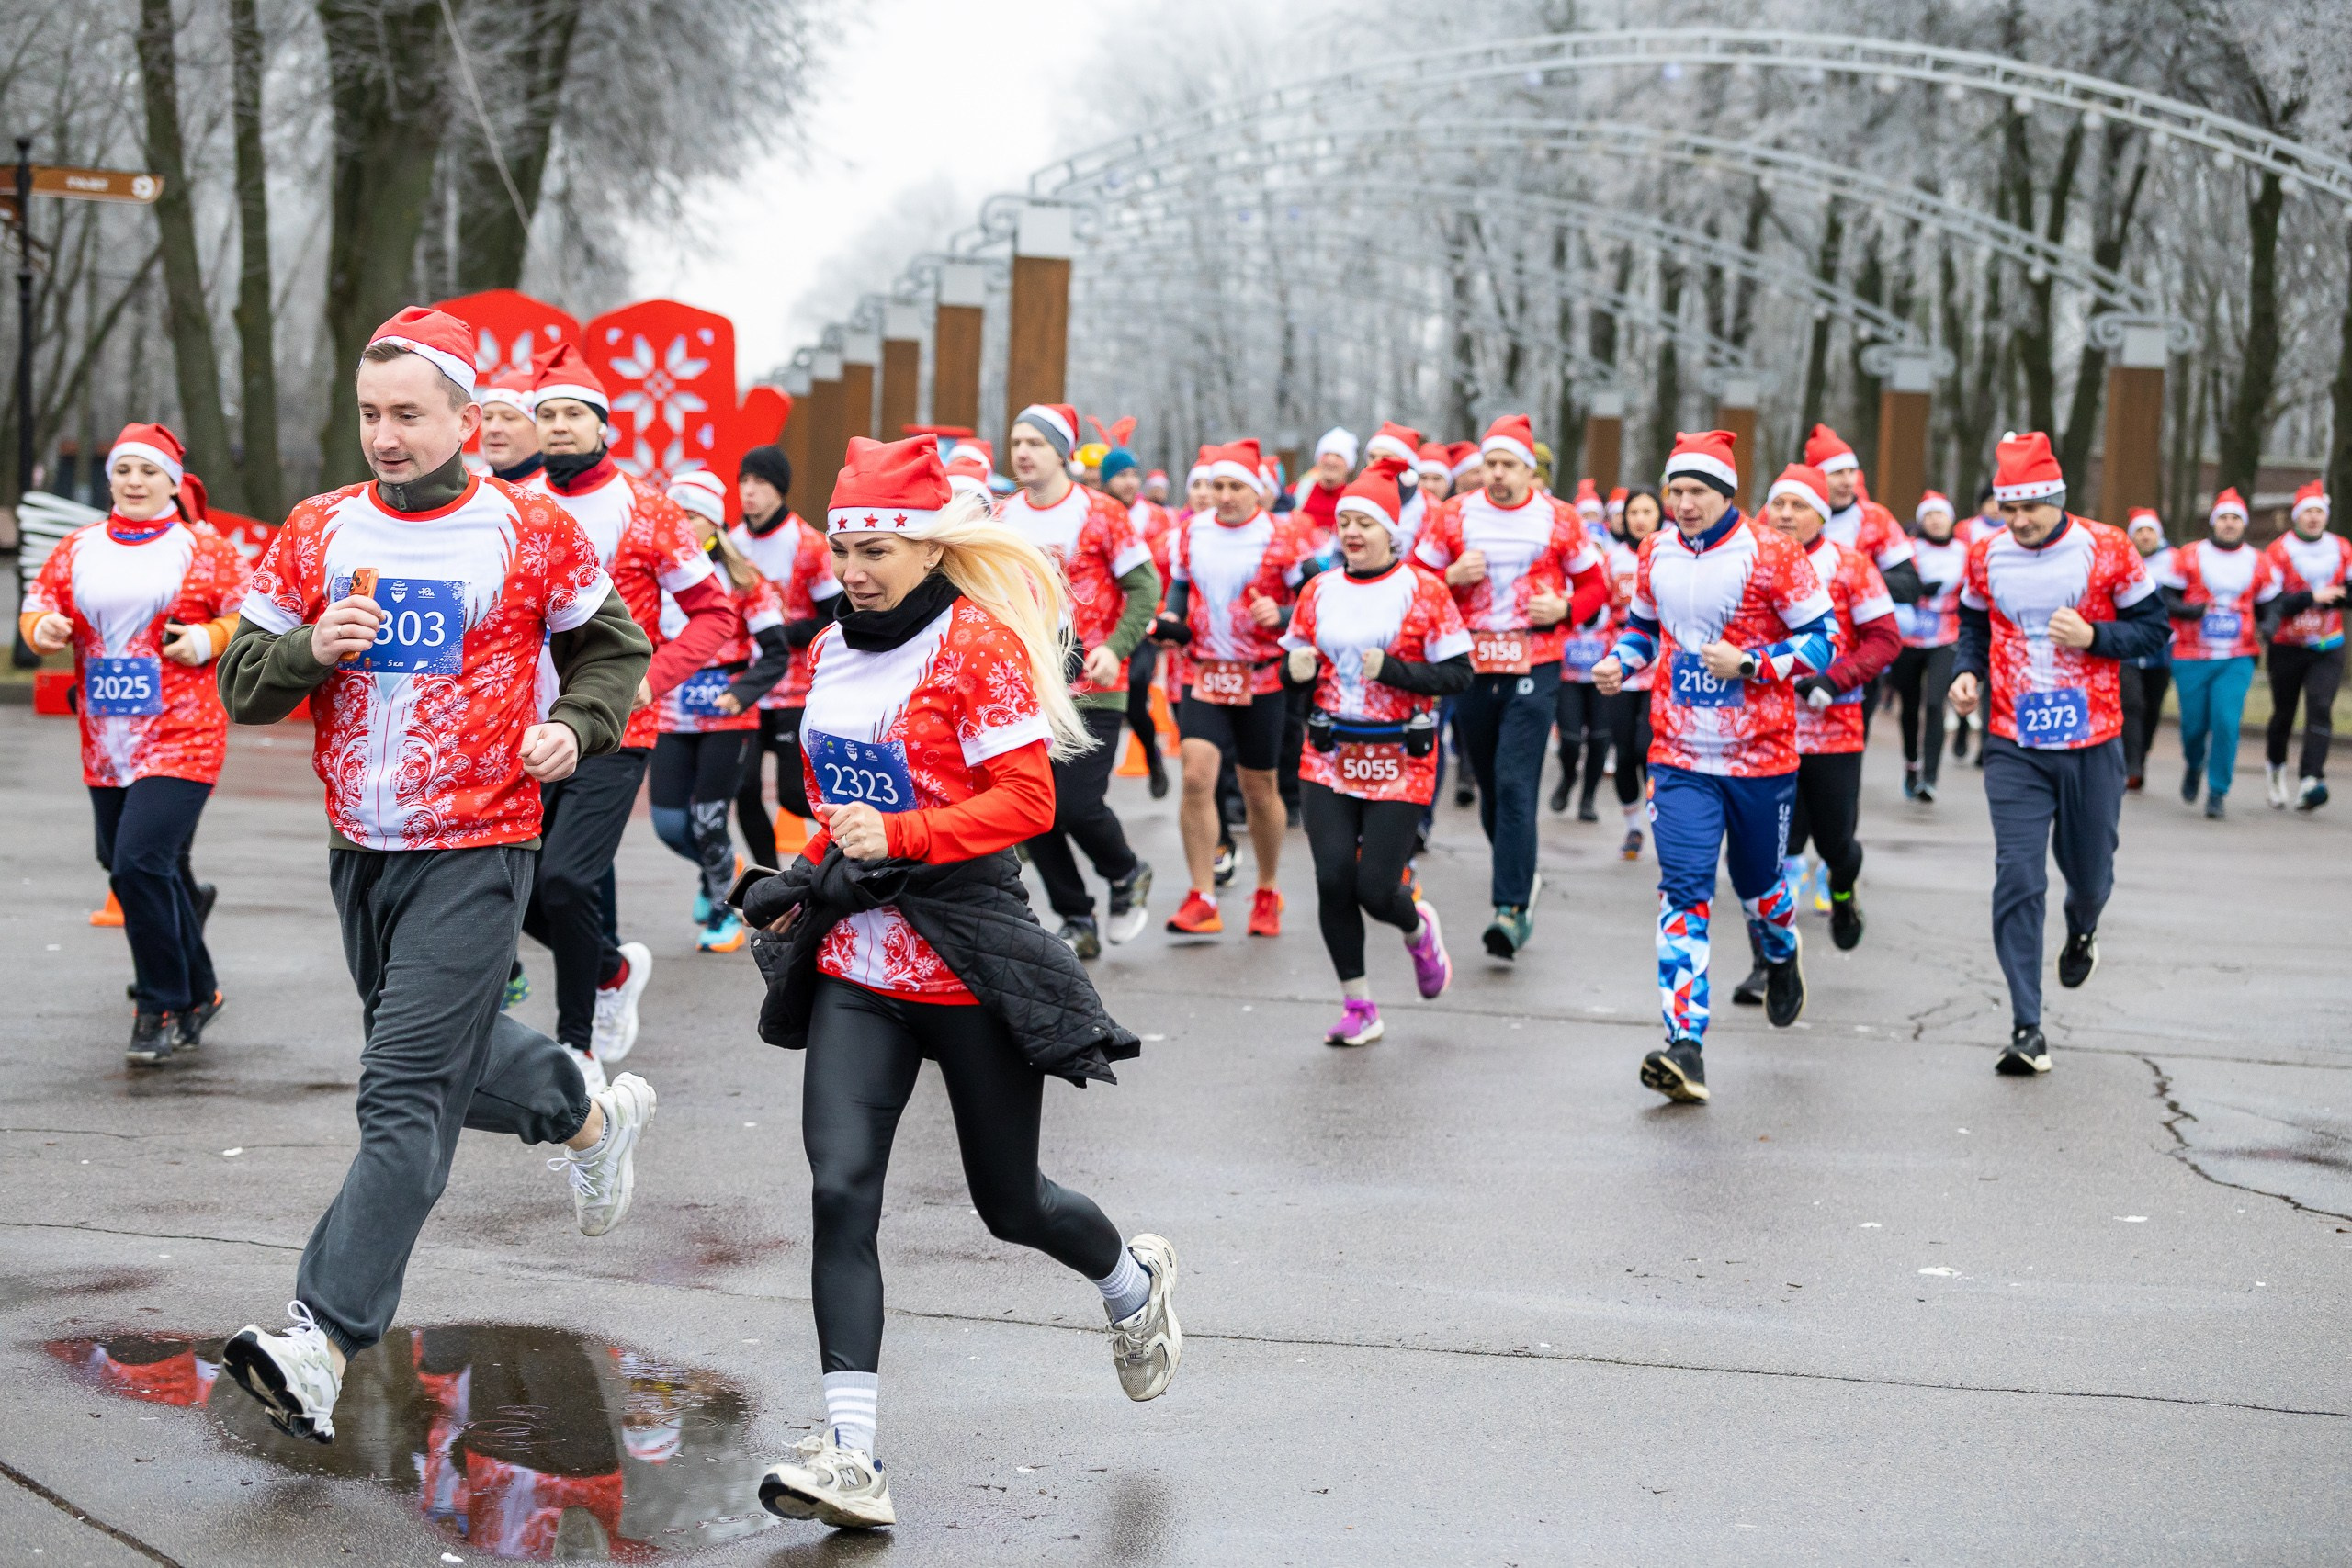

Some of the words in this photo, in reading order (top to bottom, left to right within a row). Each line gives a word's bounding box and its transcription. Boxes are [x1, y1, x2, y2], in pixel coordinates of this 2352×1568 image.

[373, 609, 446, 647] 303
[1477, 640, 1523, 661] 5158
[92, 675, 151, 700] 2025
[1203, 671, 1244, 694] 5152
[2025, 705, 2078, 732] 2373
[1343, 758, 1399, 780] 5055
[824, 763, 899, 805] 2323
